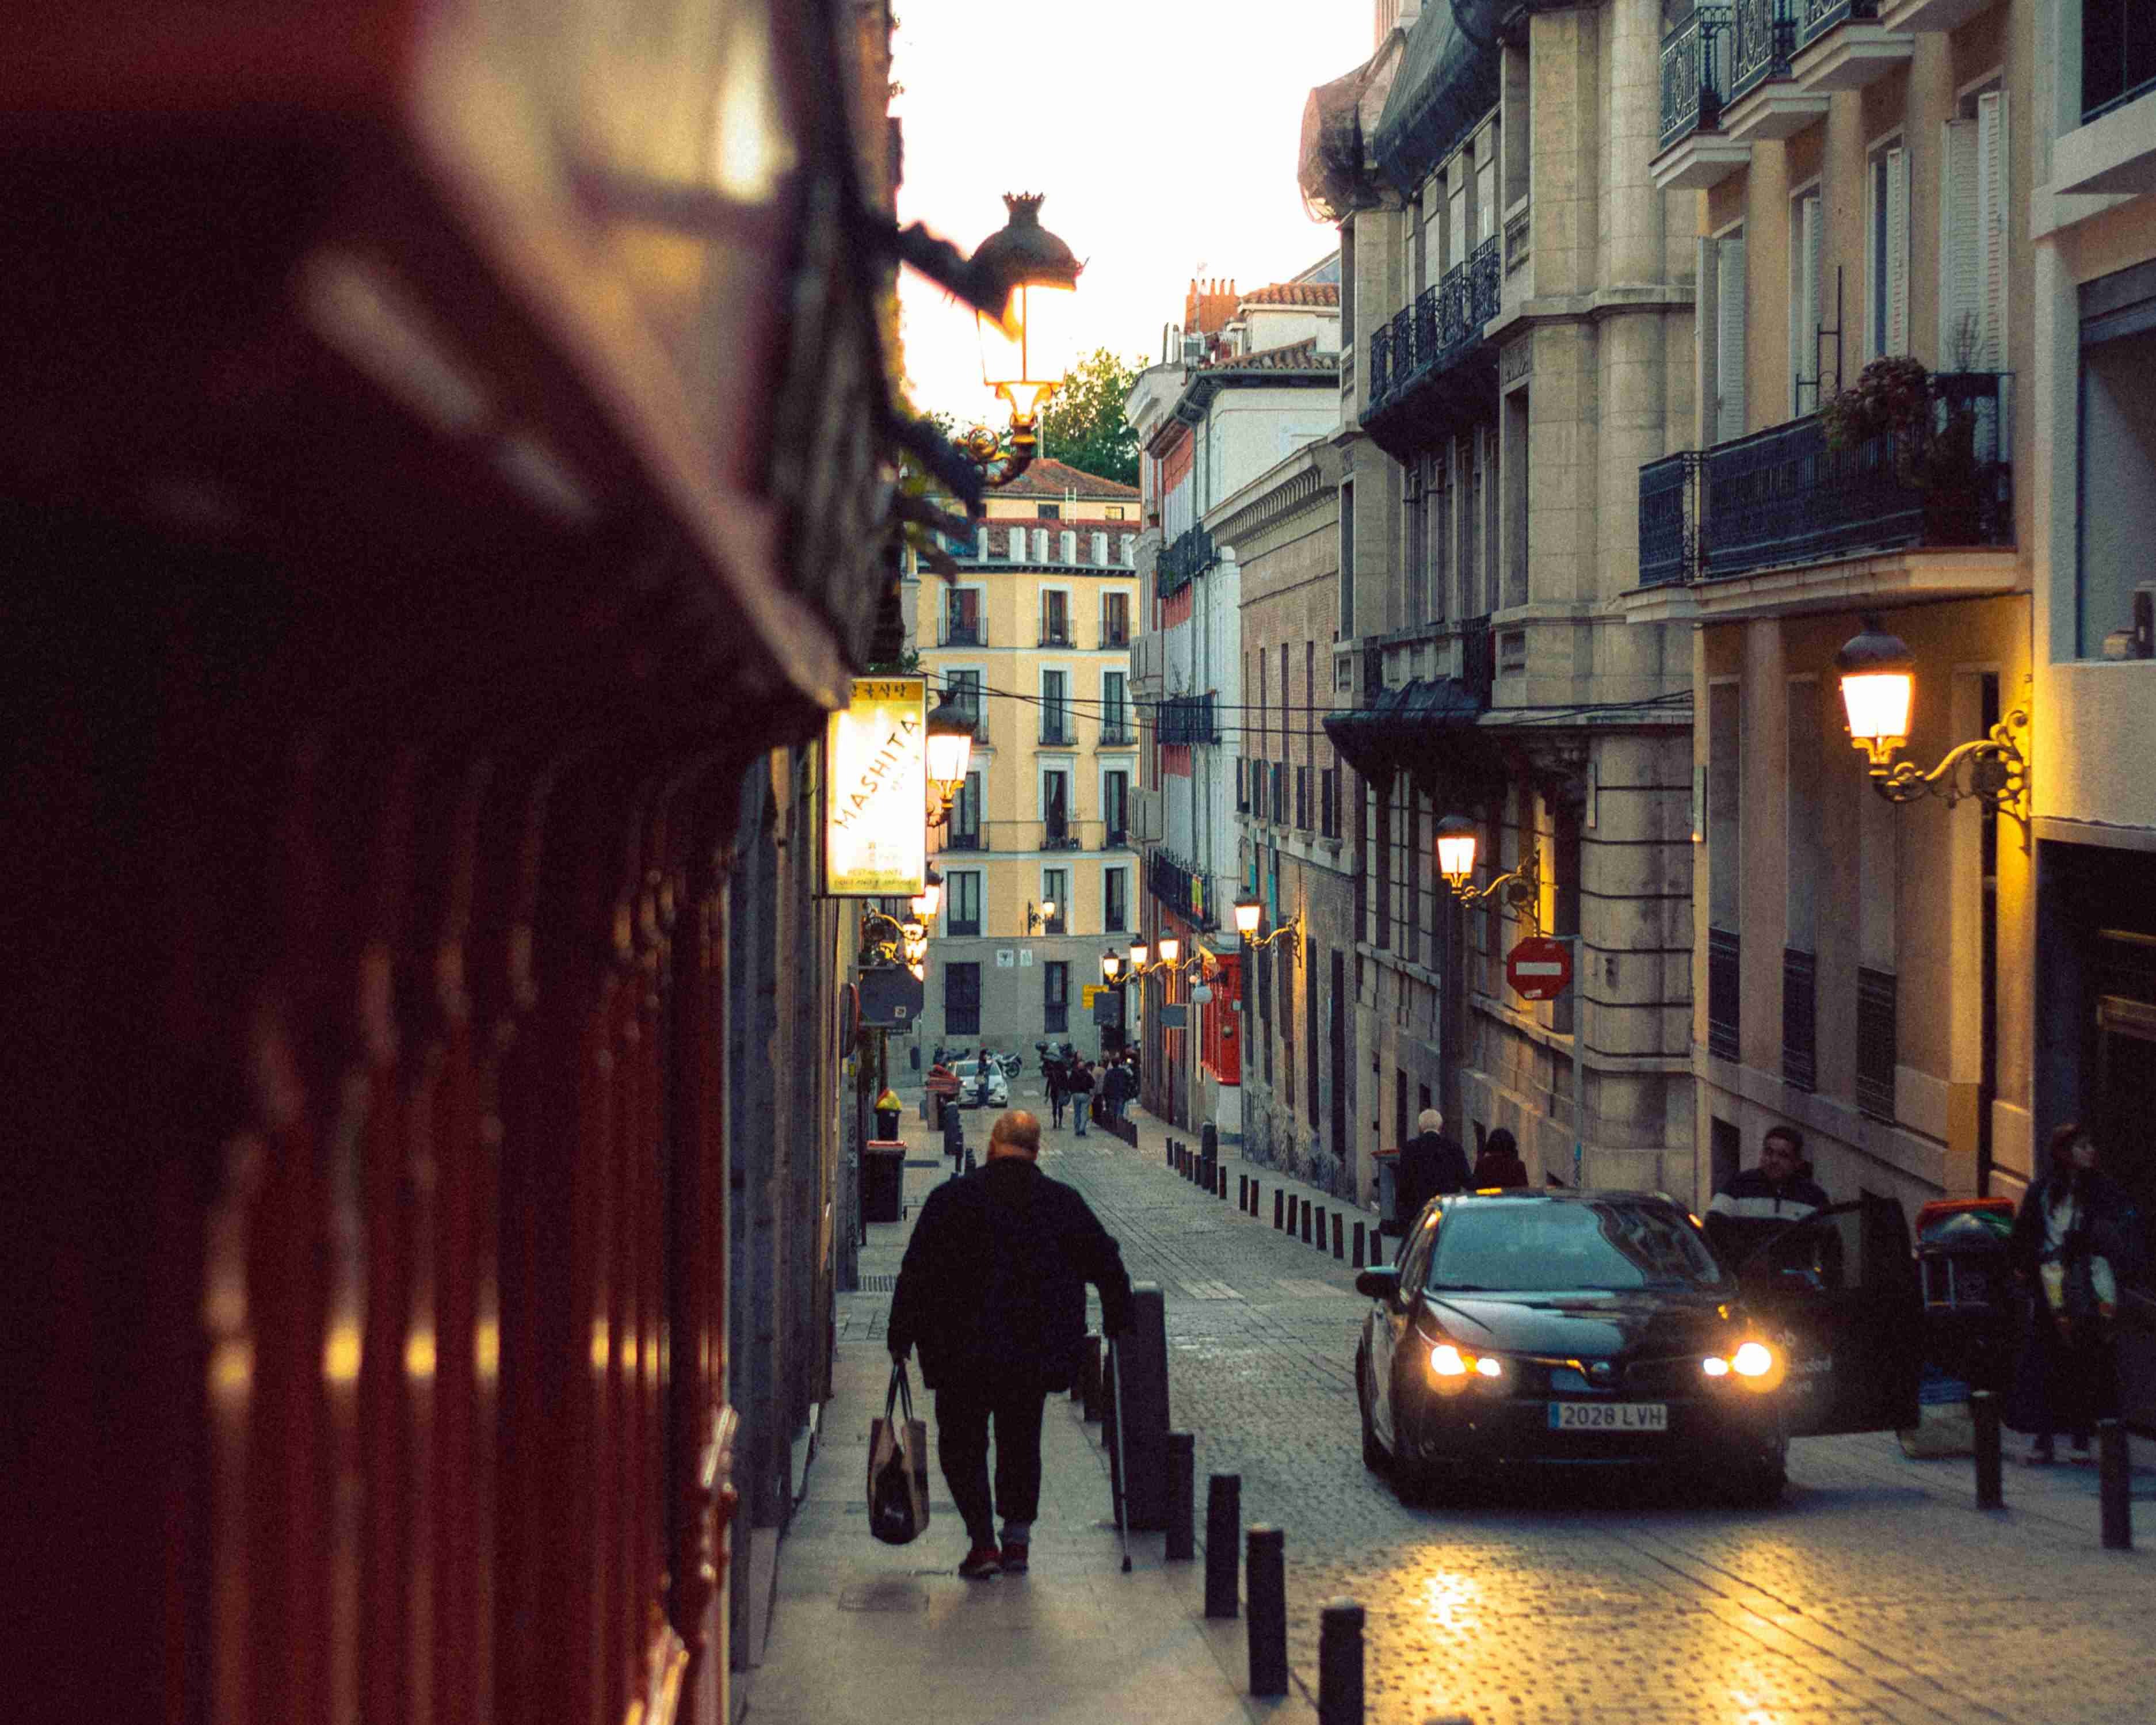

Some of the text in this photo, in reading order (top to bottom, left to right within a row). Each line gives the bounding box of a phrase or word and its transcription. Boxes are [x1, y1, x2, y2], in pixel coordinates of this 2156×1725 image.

[834, 719, 921, 829] MASHITA
[1564, 1406, 1662, 1426] 2028 LVH
